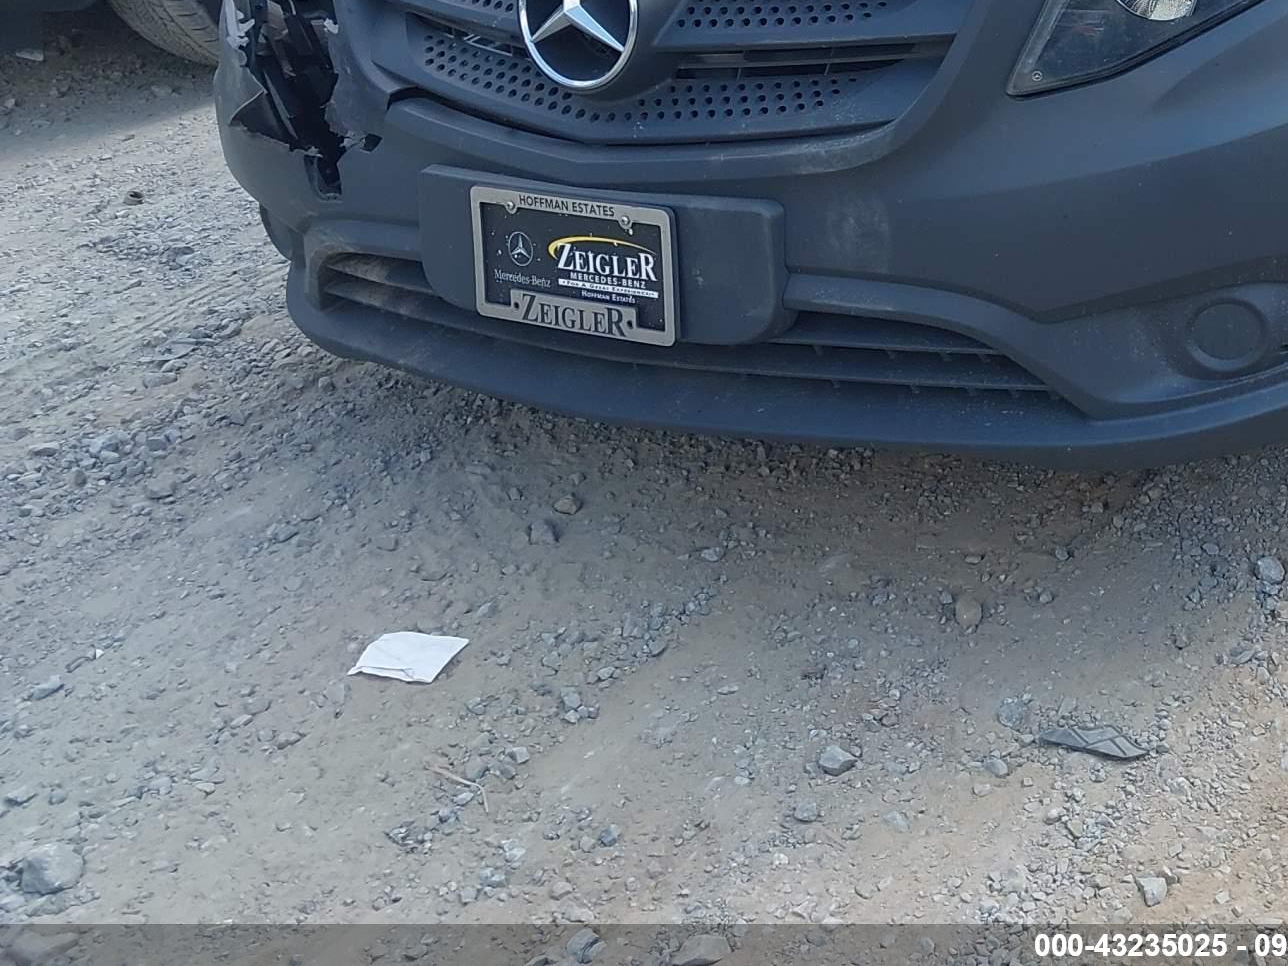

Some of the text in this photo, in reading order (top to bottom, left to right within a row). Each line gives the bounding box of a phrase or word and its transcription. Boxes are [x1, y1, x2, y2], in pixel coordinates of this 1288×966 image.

[519, 194, 615, 218] HOFFMAN ESTATES
[557, 243, 659, 282] ZEIGLER
[493, 268, 552, 289] Mercedes-Benz
[570, 271, 647, 289] MERCEDES-BENZ
[520, 292, 627, 337] ZEIGLER
